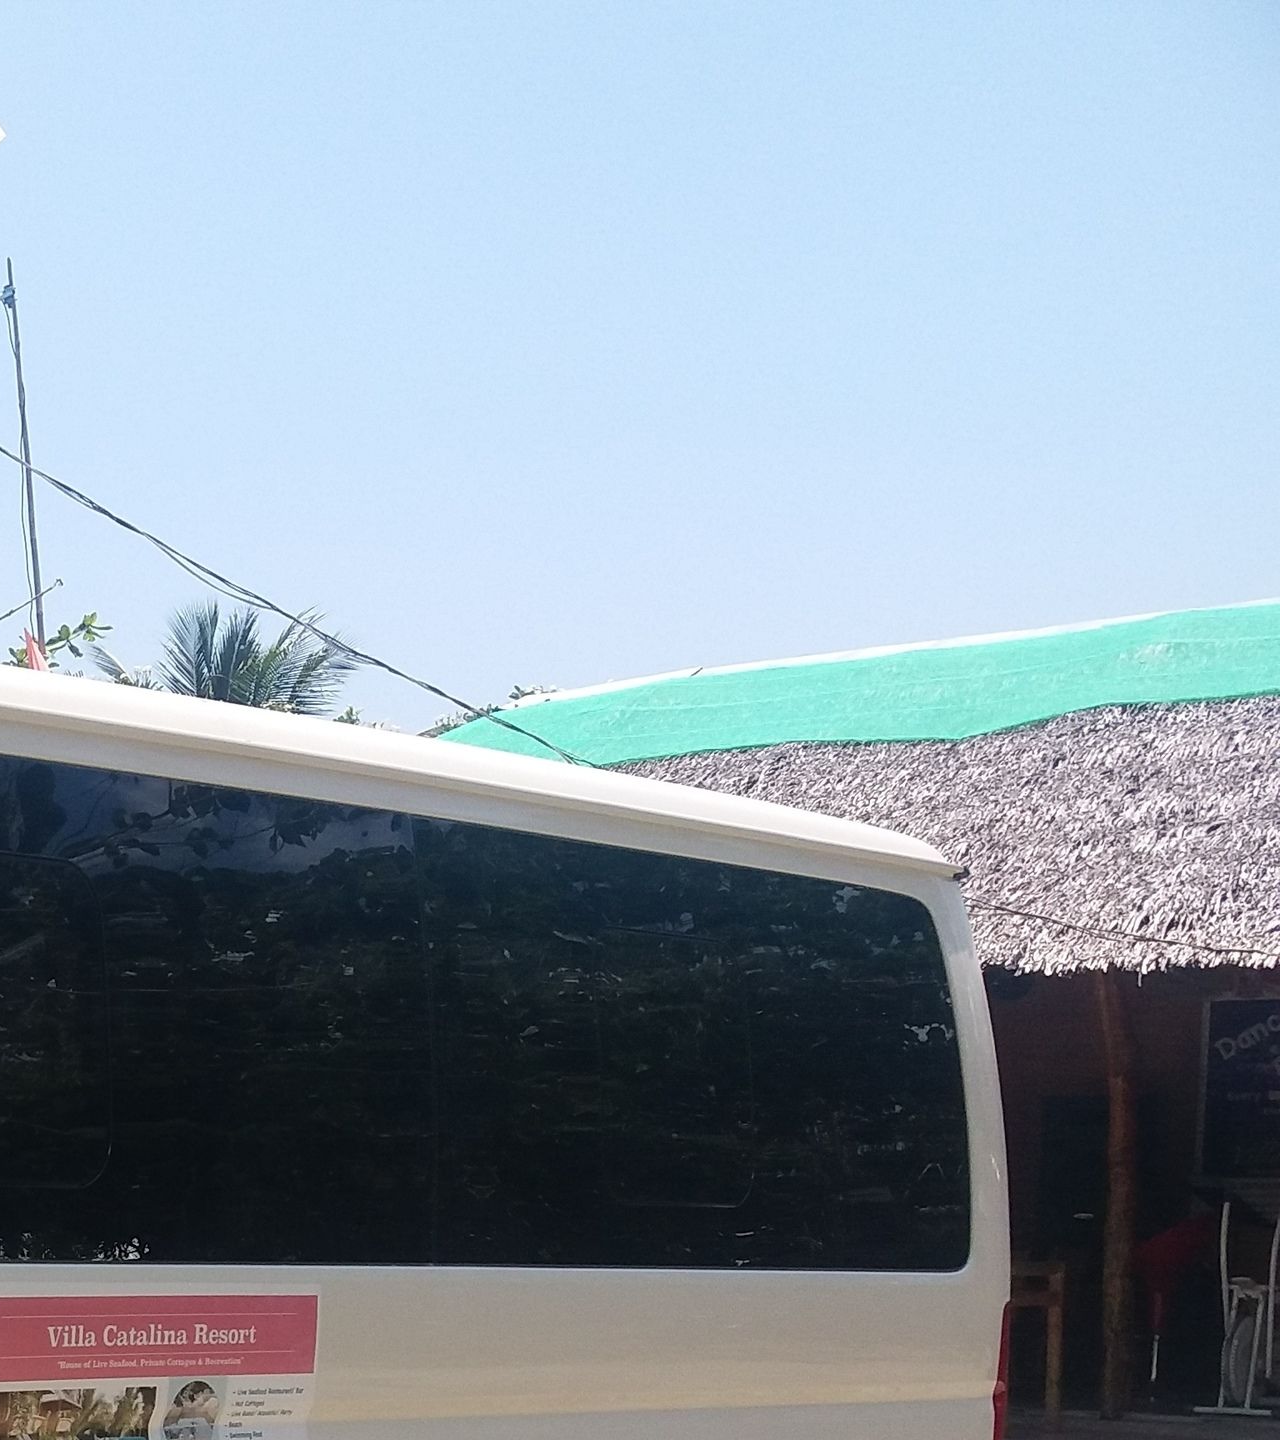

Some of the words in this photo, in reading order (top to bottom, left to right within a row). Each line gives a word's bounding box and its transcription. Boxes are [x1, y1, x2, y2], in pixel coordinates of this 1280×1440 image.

[48, 1326, 97, 1347] Villa
[103, 1324, 188, 1346] Catalina
[194, 1324, 257, 1345] Resort
[83, 1360, 91, 1368] of
[93, 1359, 108, 1368] Live
